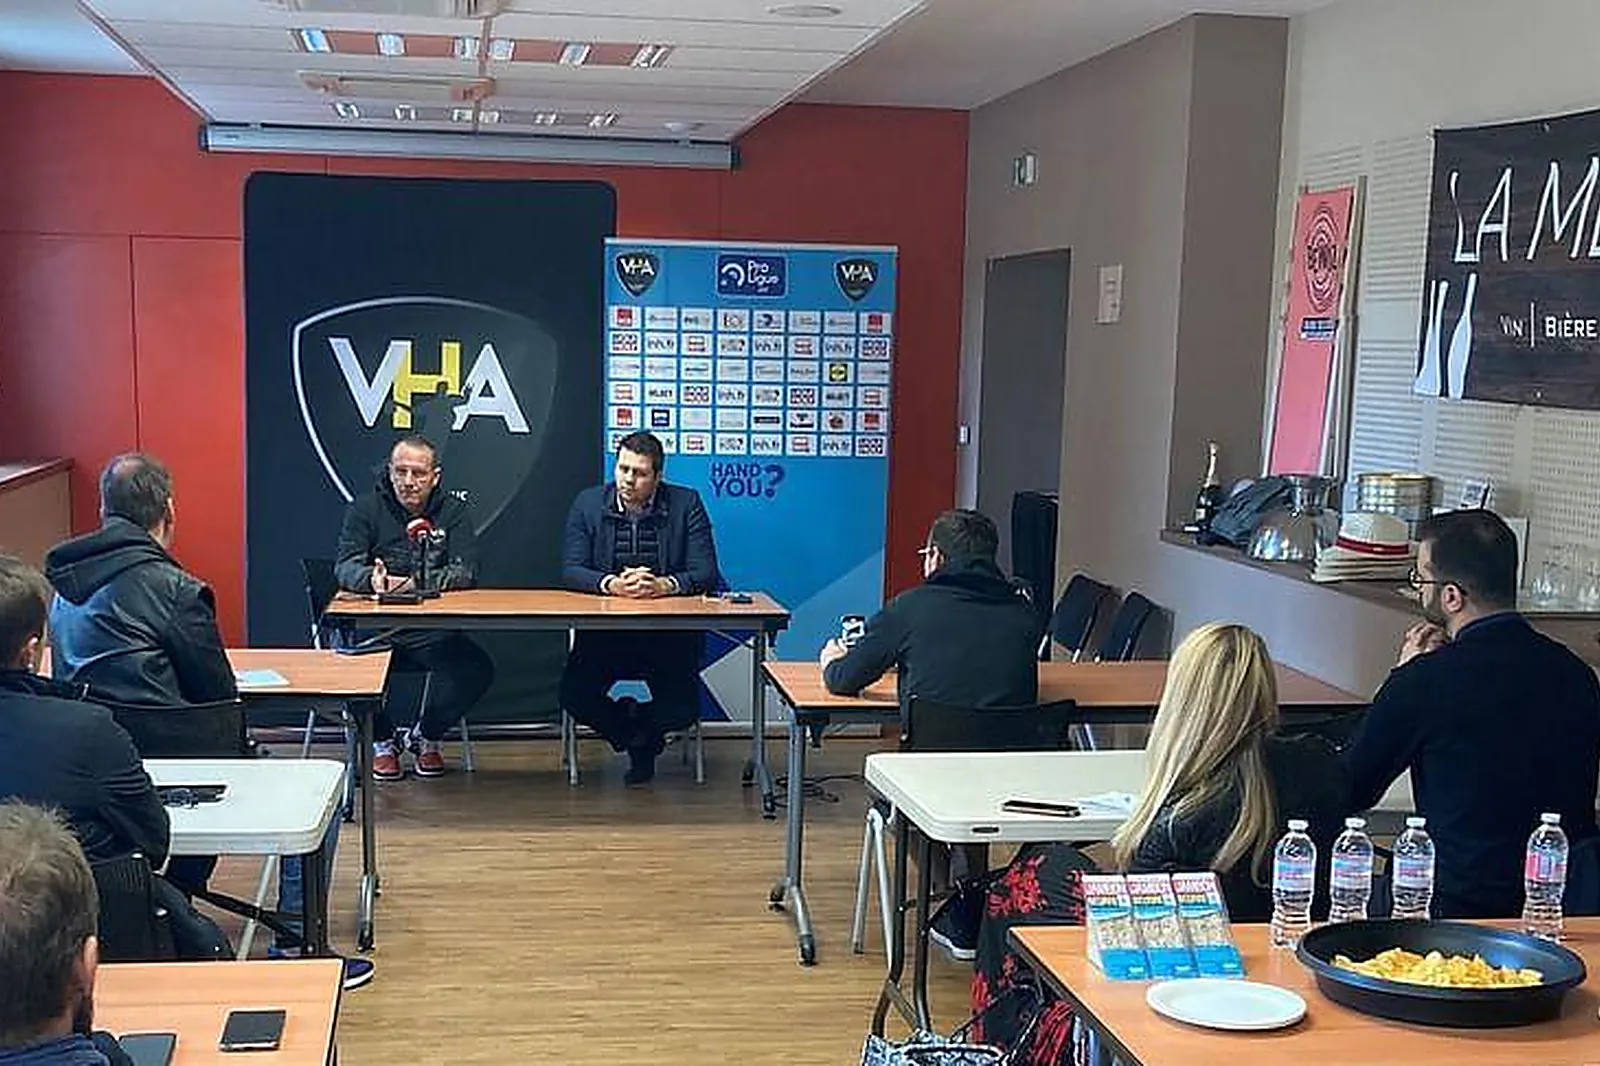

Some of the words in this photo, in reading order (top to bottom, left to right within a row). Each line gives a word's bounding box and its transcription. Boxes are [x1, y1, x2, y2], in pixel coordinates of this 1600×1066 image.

[1450, 167, 1512, 262] LA
[1526, 156, 1600, 260] M
[1545, 311, 1597, 337] BIÈRE
[328, 337, 531, 433] VHA
[712, 462, 761, 477] HAND
